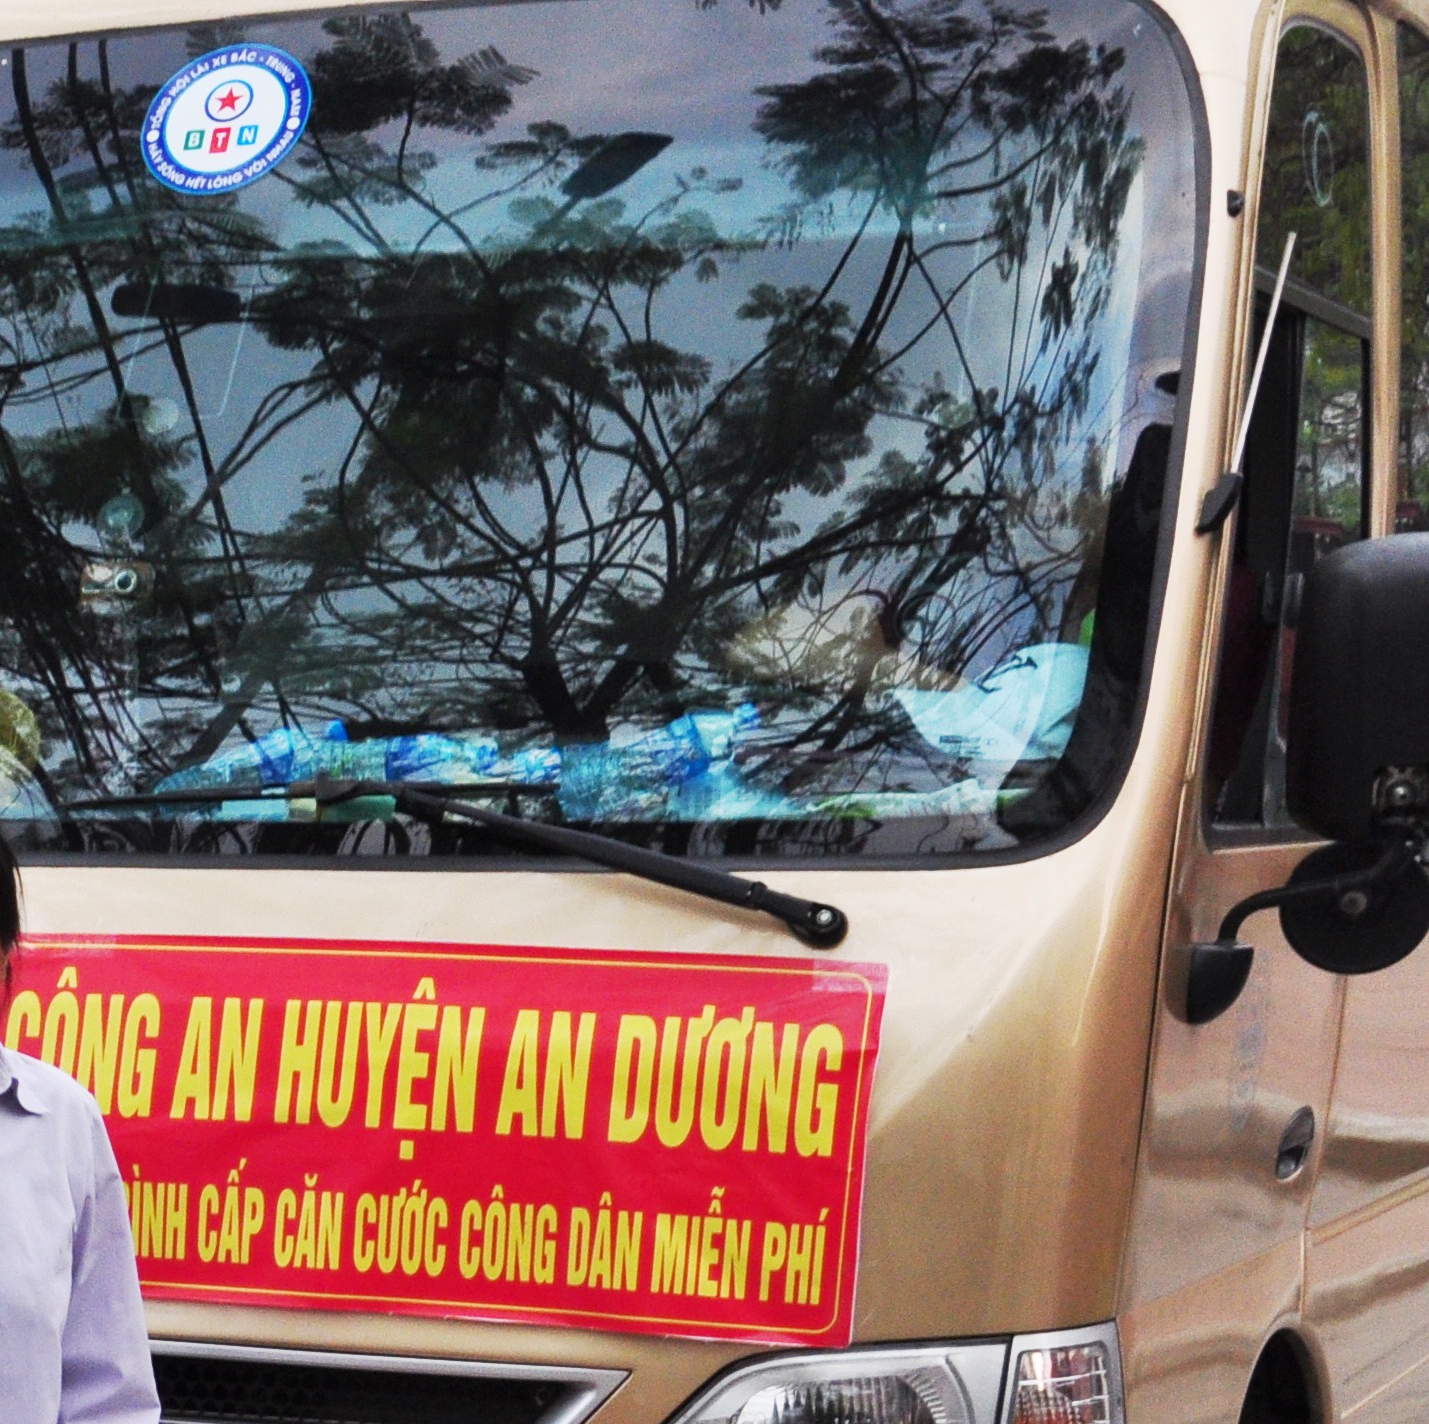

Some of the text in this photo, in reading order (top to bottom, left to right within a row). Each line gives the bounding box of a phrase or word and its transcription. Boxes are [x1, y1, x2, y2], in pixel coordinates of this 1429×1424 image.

[4, 965, 162, 1119] CÔNG
[169, 995, 265, 1123] AN
[273, 975, 487, 1162] HUYỆN
[494, 1008, 598, 1141] AN
[607, 1004, 844, 1158] DƯƠNG
[197, 1157, 265, 1265] CẤP
[273, 1173, 344, 1271] CĂN
[353, 1179, 449, 1278] CƯỚC
[458, 1184, 558, 1285] CÔNG
[566, 1191, 644, 1292] DÂN
[650, 1185, 753, 1300] MIỄN
[758, 1207, 831, 1306] PHÍ
